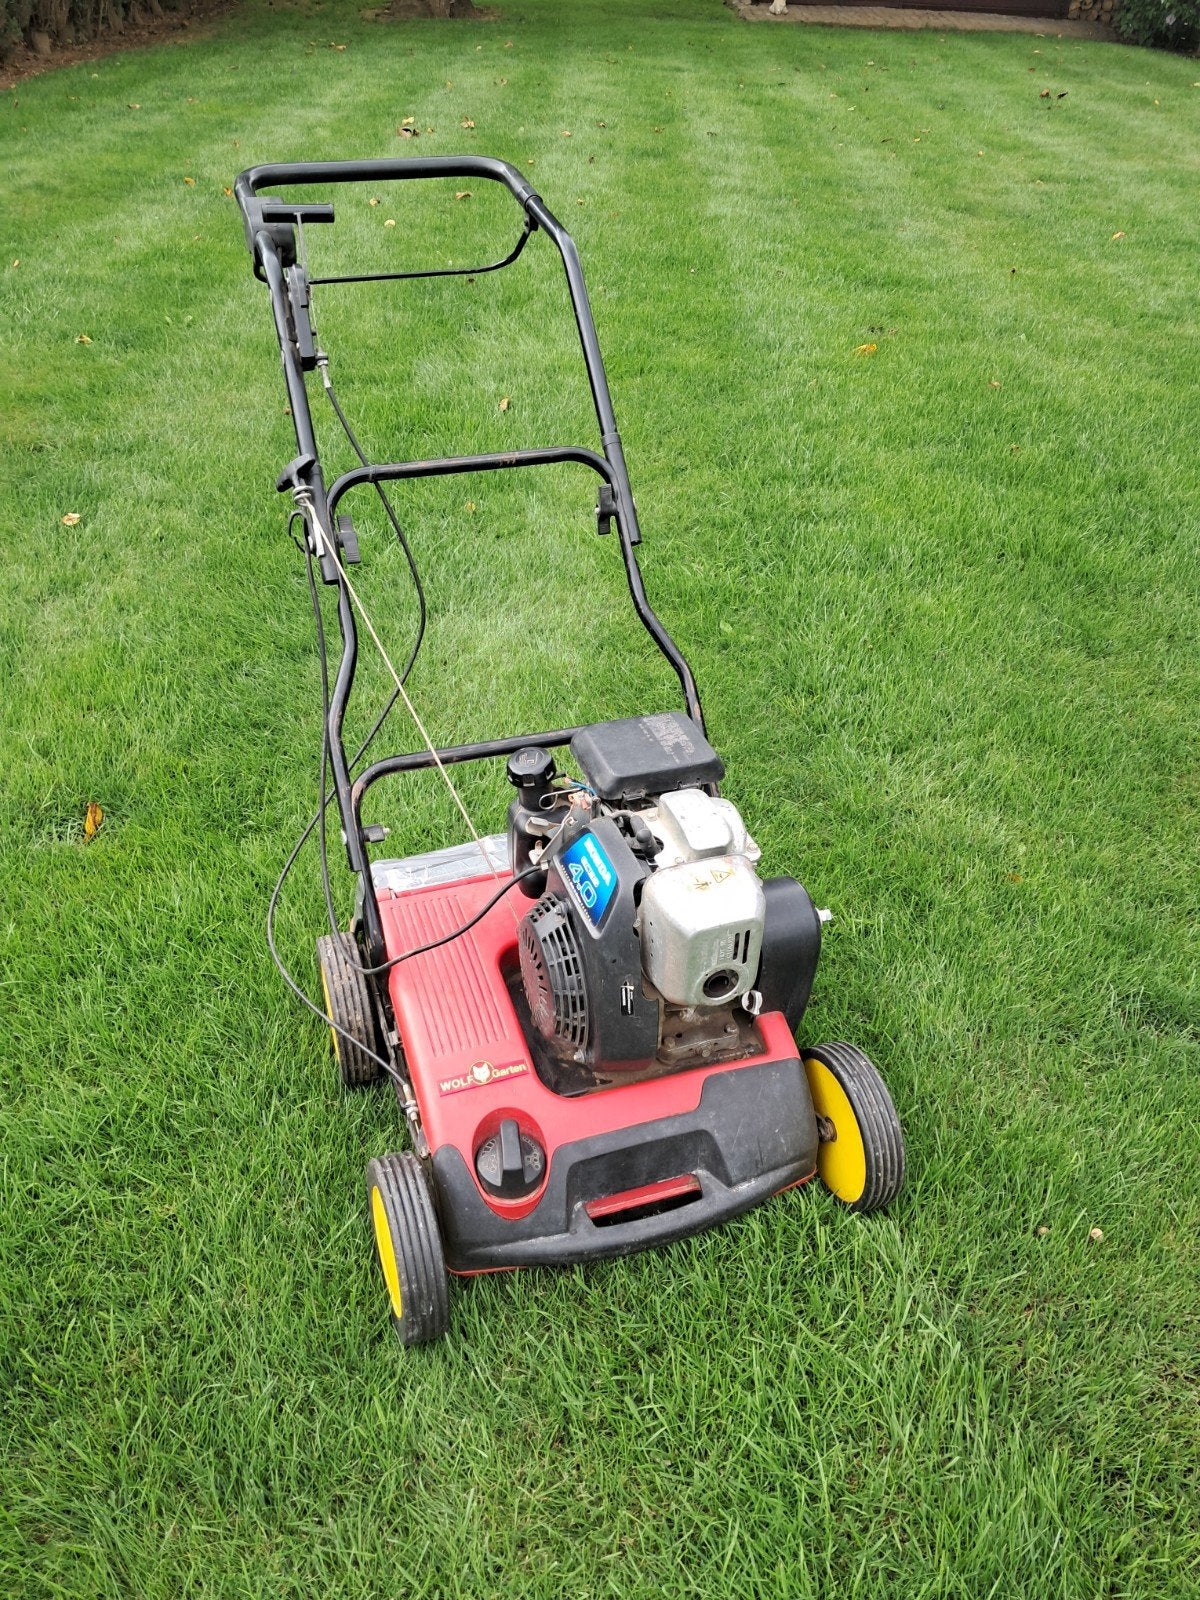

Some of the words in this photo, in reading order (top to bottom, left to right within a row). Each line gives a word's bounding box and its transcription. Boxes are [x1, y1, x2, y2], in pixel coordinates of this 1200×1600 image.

[568, 863, 597, 908] 4.0
[440, 1075, 473, 1092] WOLF
[492, 1063, 526, 1078] Garten
